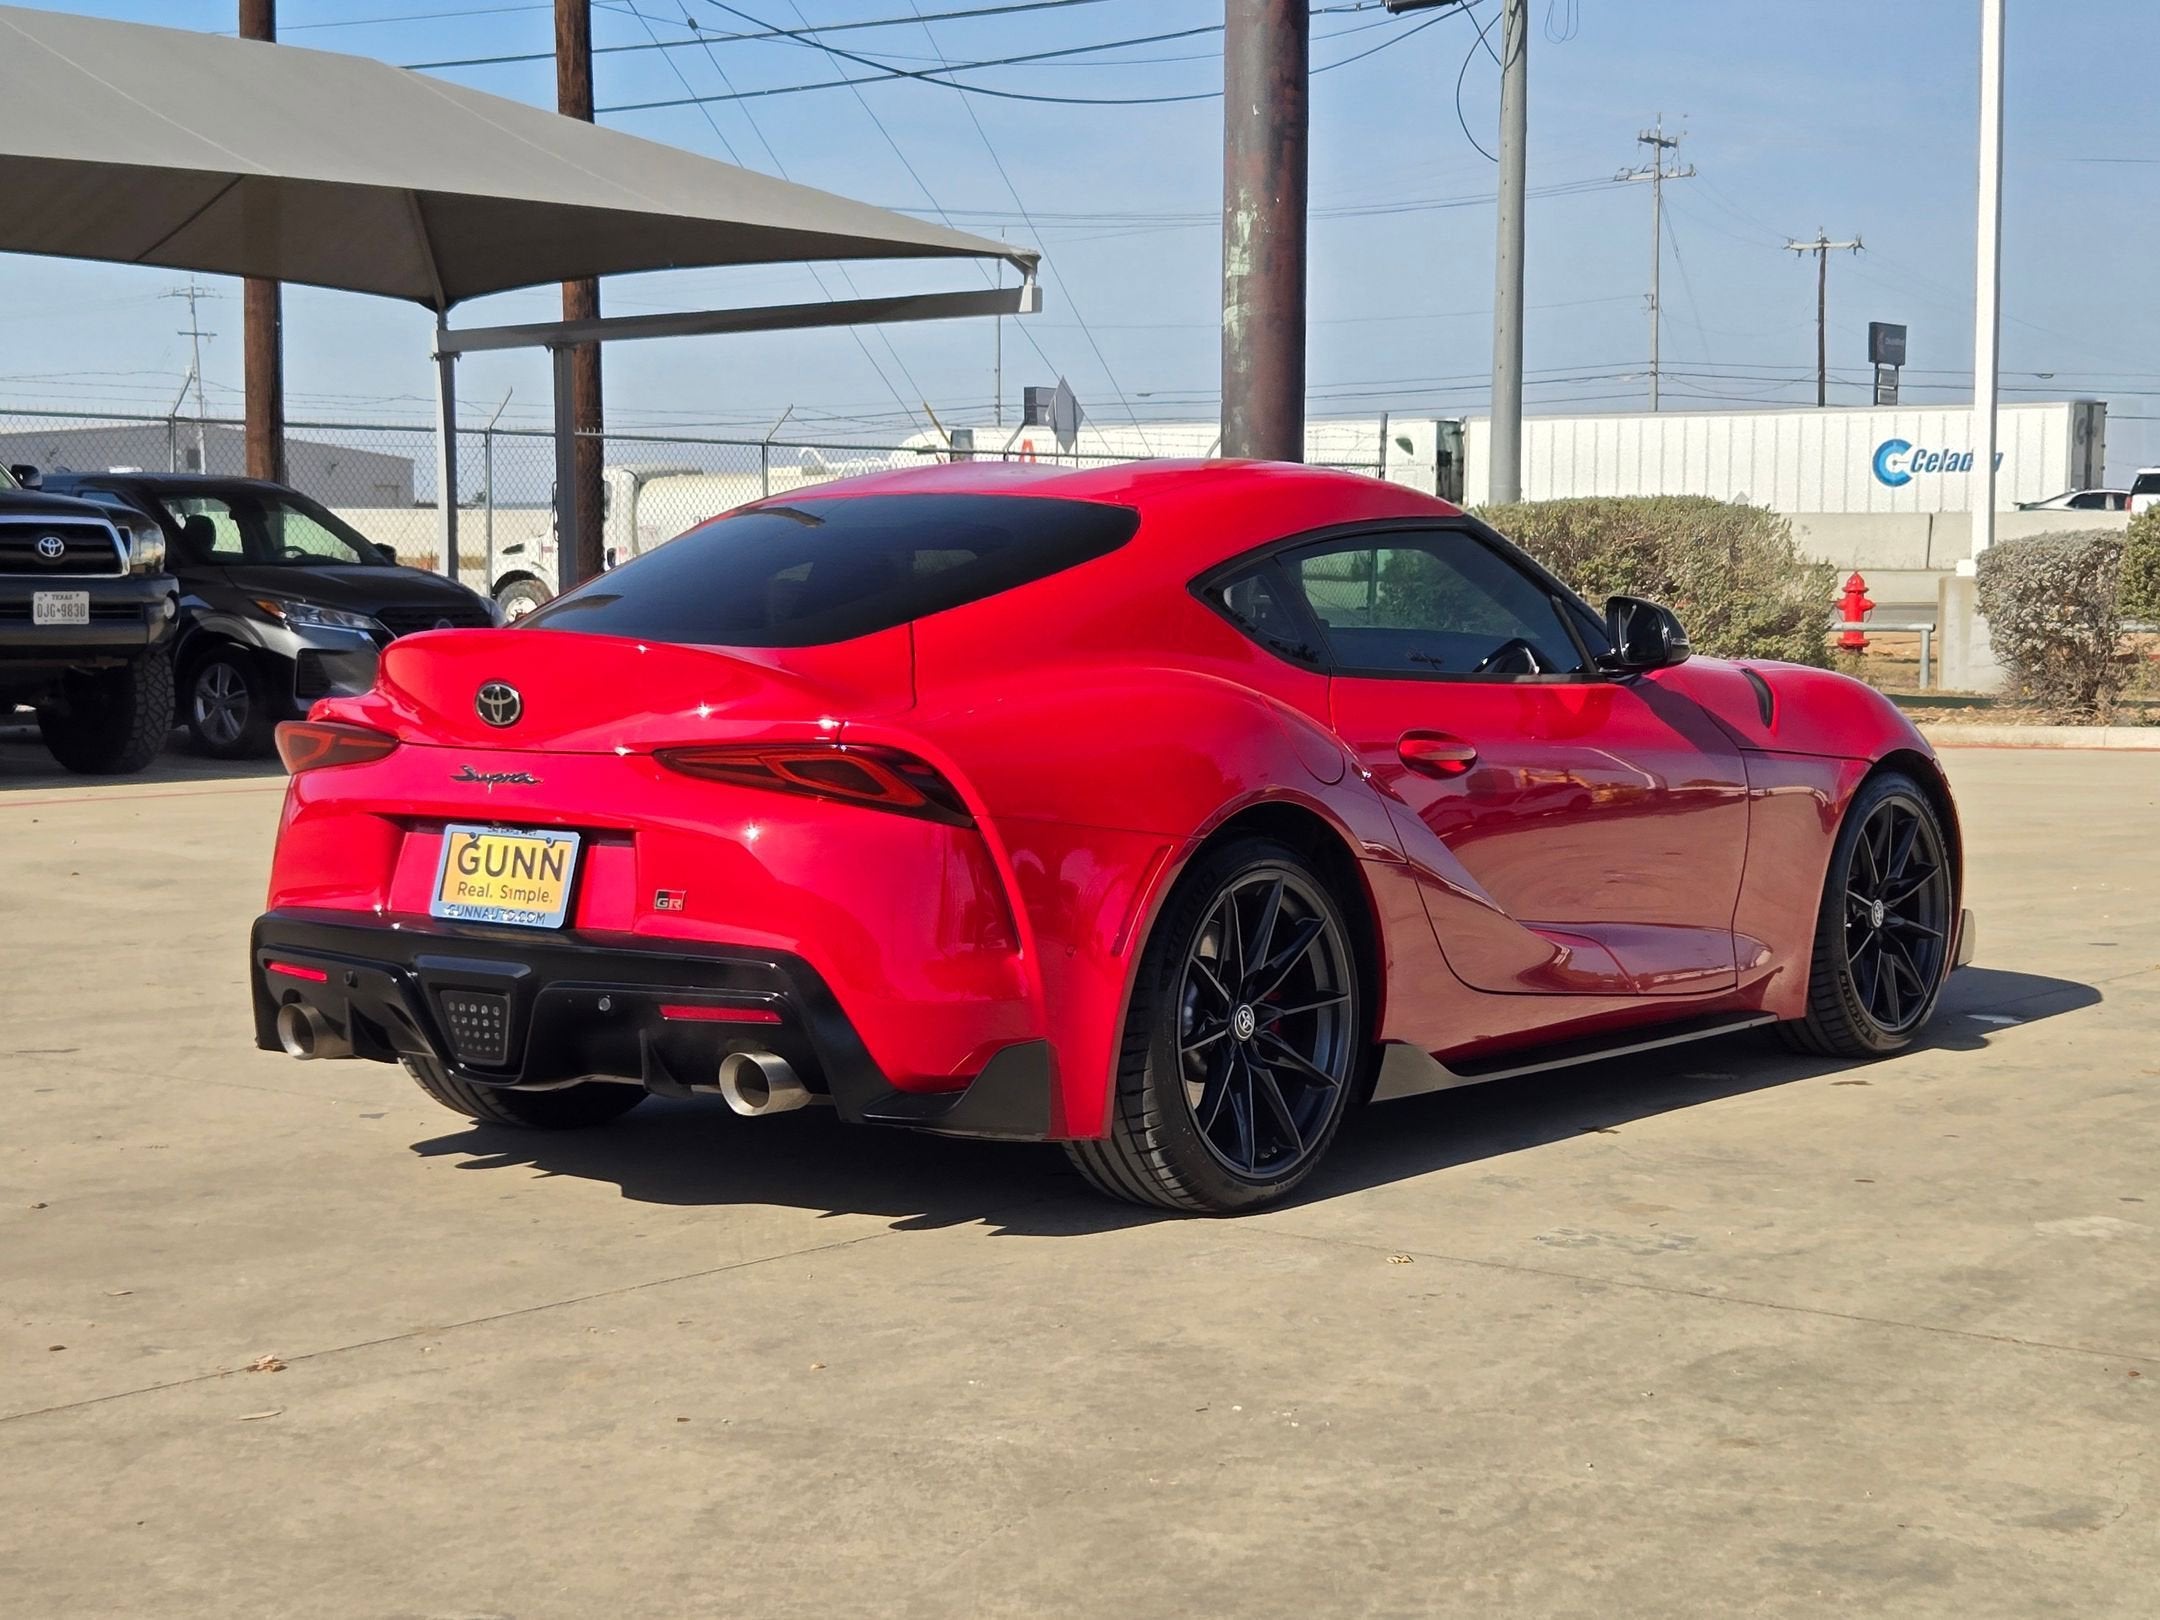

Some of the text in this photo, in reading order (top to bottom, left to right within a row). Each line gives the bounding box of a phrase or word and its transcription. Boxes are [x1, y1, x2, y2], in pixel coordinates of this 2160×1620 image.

[1910, 448, 2004, 473] Celad
[450, 765, 544, 794] Supra
[457, 841, 565, 882] GUNN
[457, 881, 493, 898] Real.
[447, 903, 546, 925] GUNNAUTO.COM
[656, 897, 683, 909] GR
